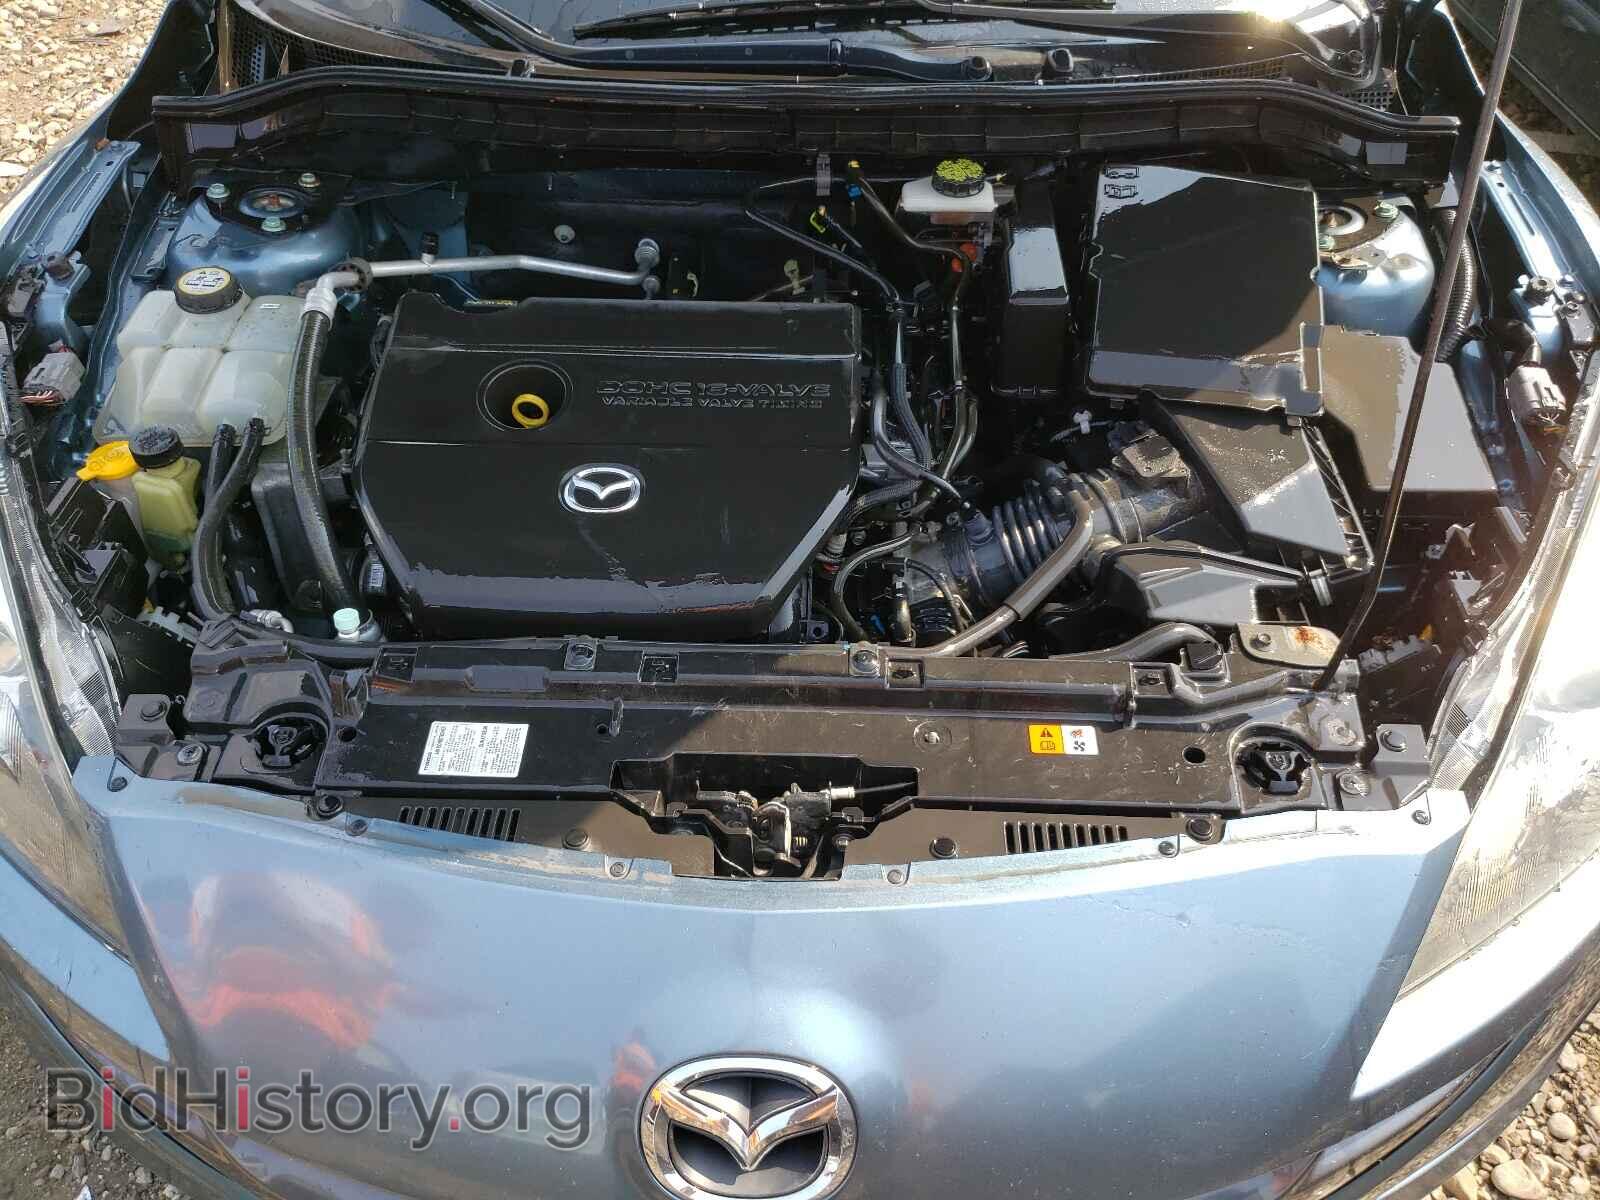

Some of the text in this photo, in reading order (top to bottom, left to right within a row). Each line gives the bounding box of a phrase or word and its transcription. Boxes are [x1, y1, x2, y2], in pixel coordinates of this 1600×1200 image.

[597, 380, 832, 398] DOHC 16-VALVE
[697, 398, 754, 408] VALVE
